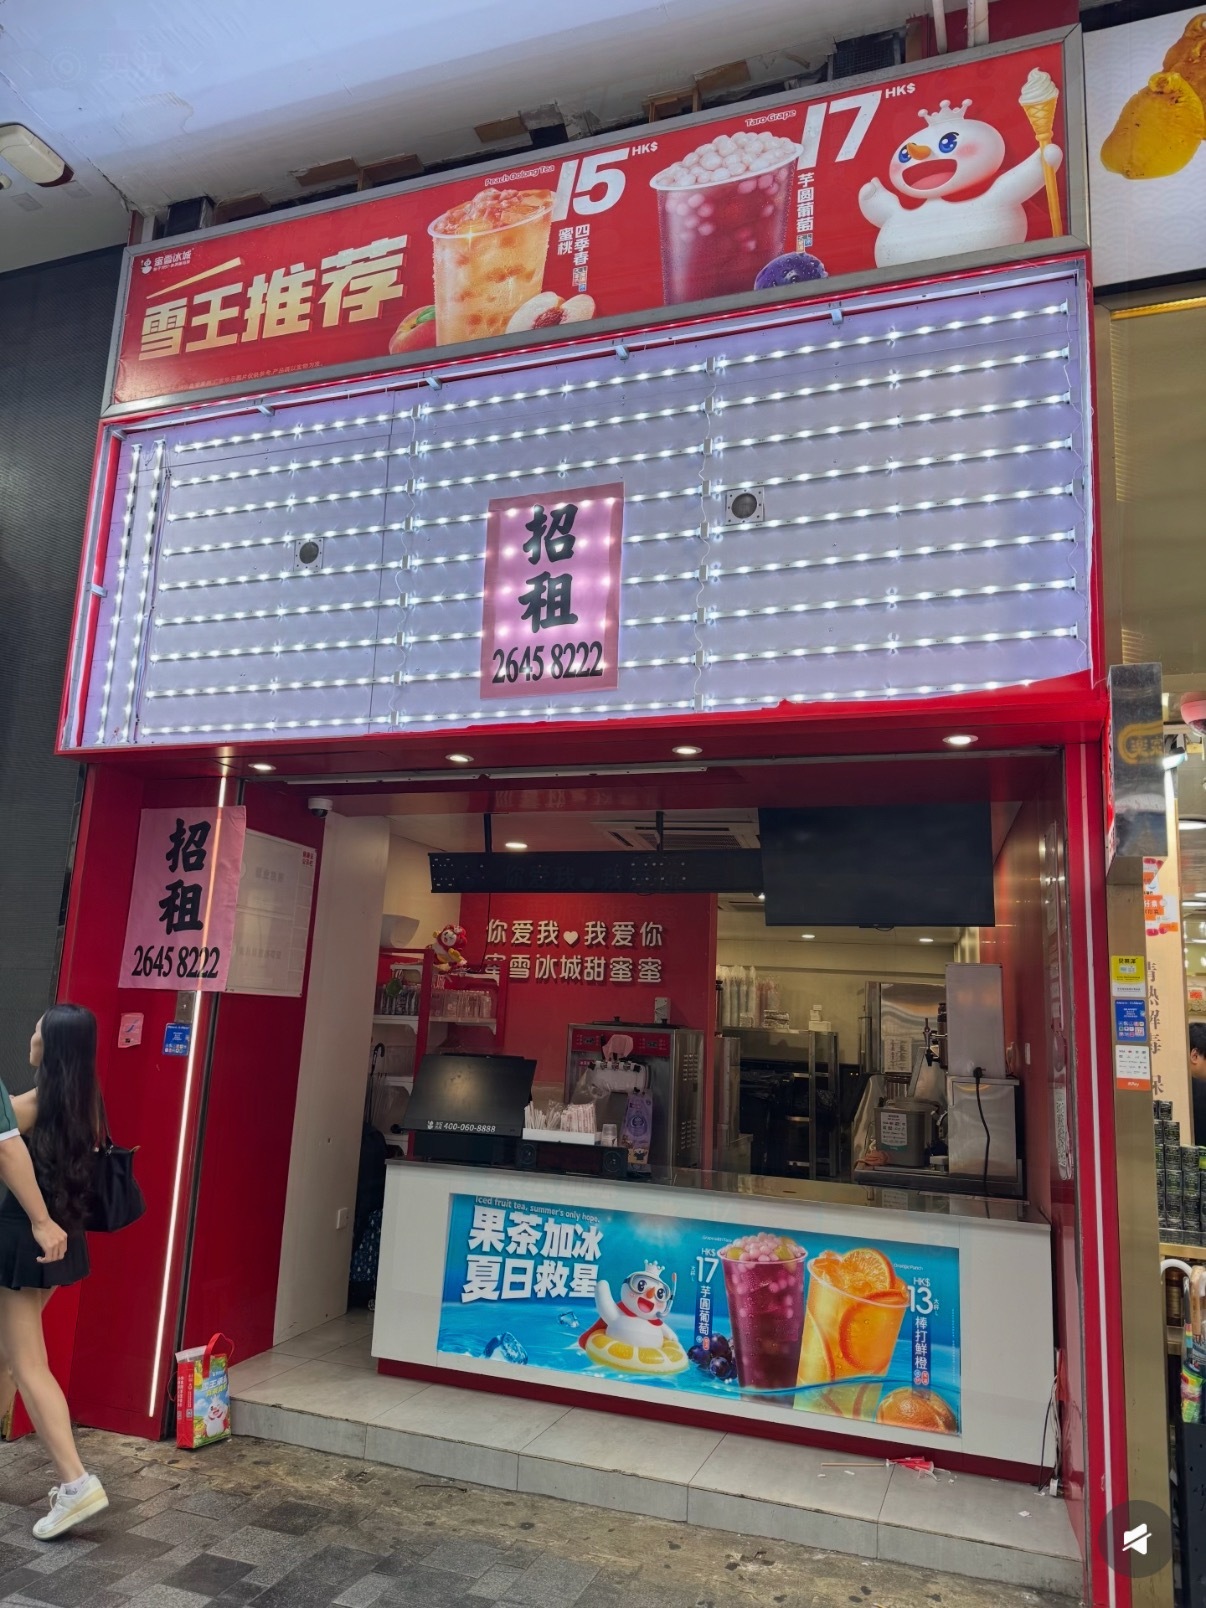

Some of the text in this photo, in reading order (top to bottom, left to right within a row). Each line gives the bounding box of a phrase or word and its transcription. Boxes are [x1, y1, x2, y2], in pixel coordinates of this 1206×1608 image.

[745, 109, 797, 127] Taro Grape
[797, 83, 916, 171] 17 HK$
[485, 164, 555, 187] Peach Oolong Tea
[551, 141, 658, 222] 15 HK$
[557, 227, 574, 255] 蜜桃
[573, 223, 590, 266] 四季春
[138, 234, 408, 361] 雪王推荐
[517, 503, 579, 634] 招租
[492, 640, 604, 684] 2645 8222
[158, 817, 212, 935] 招租
[486, 919, 663, 947] 你爱我 我爱你
[131, 945, 173, 977] 2645
[176, 946, 221, 978] 8222
[443, 1122, 496, 1133] 400-060-8888
[475, 1195, 492, 1205] Iced
[494, 1199, 512, 1209] fruit
[530, 1205, 564, 1217] summer's
[565, 1210, 580, 1222] only
[582, 1213, 600, 1224] hope.
[467, 1203, 605, 1262] 果茶加冰
[701, 1248, 716, 1257] HK$
[461, 1254, 600, 1304] 夏日救星
[696, 1256, 719, 1283] 17
[913, 1276, 930, 1287] HK$
[907, 1285, 934, 1315] 13
[914, 1315, 928, 1370] 棒打鮮橙
